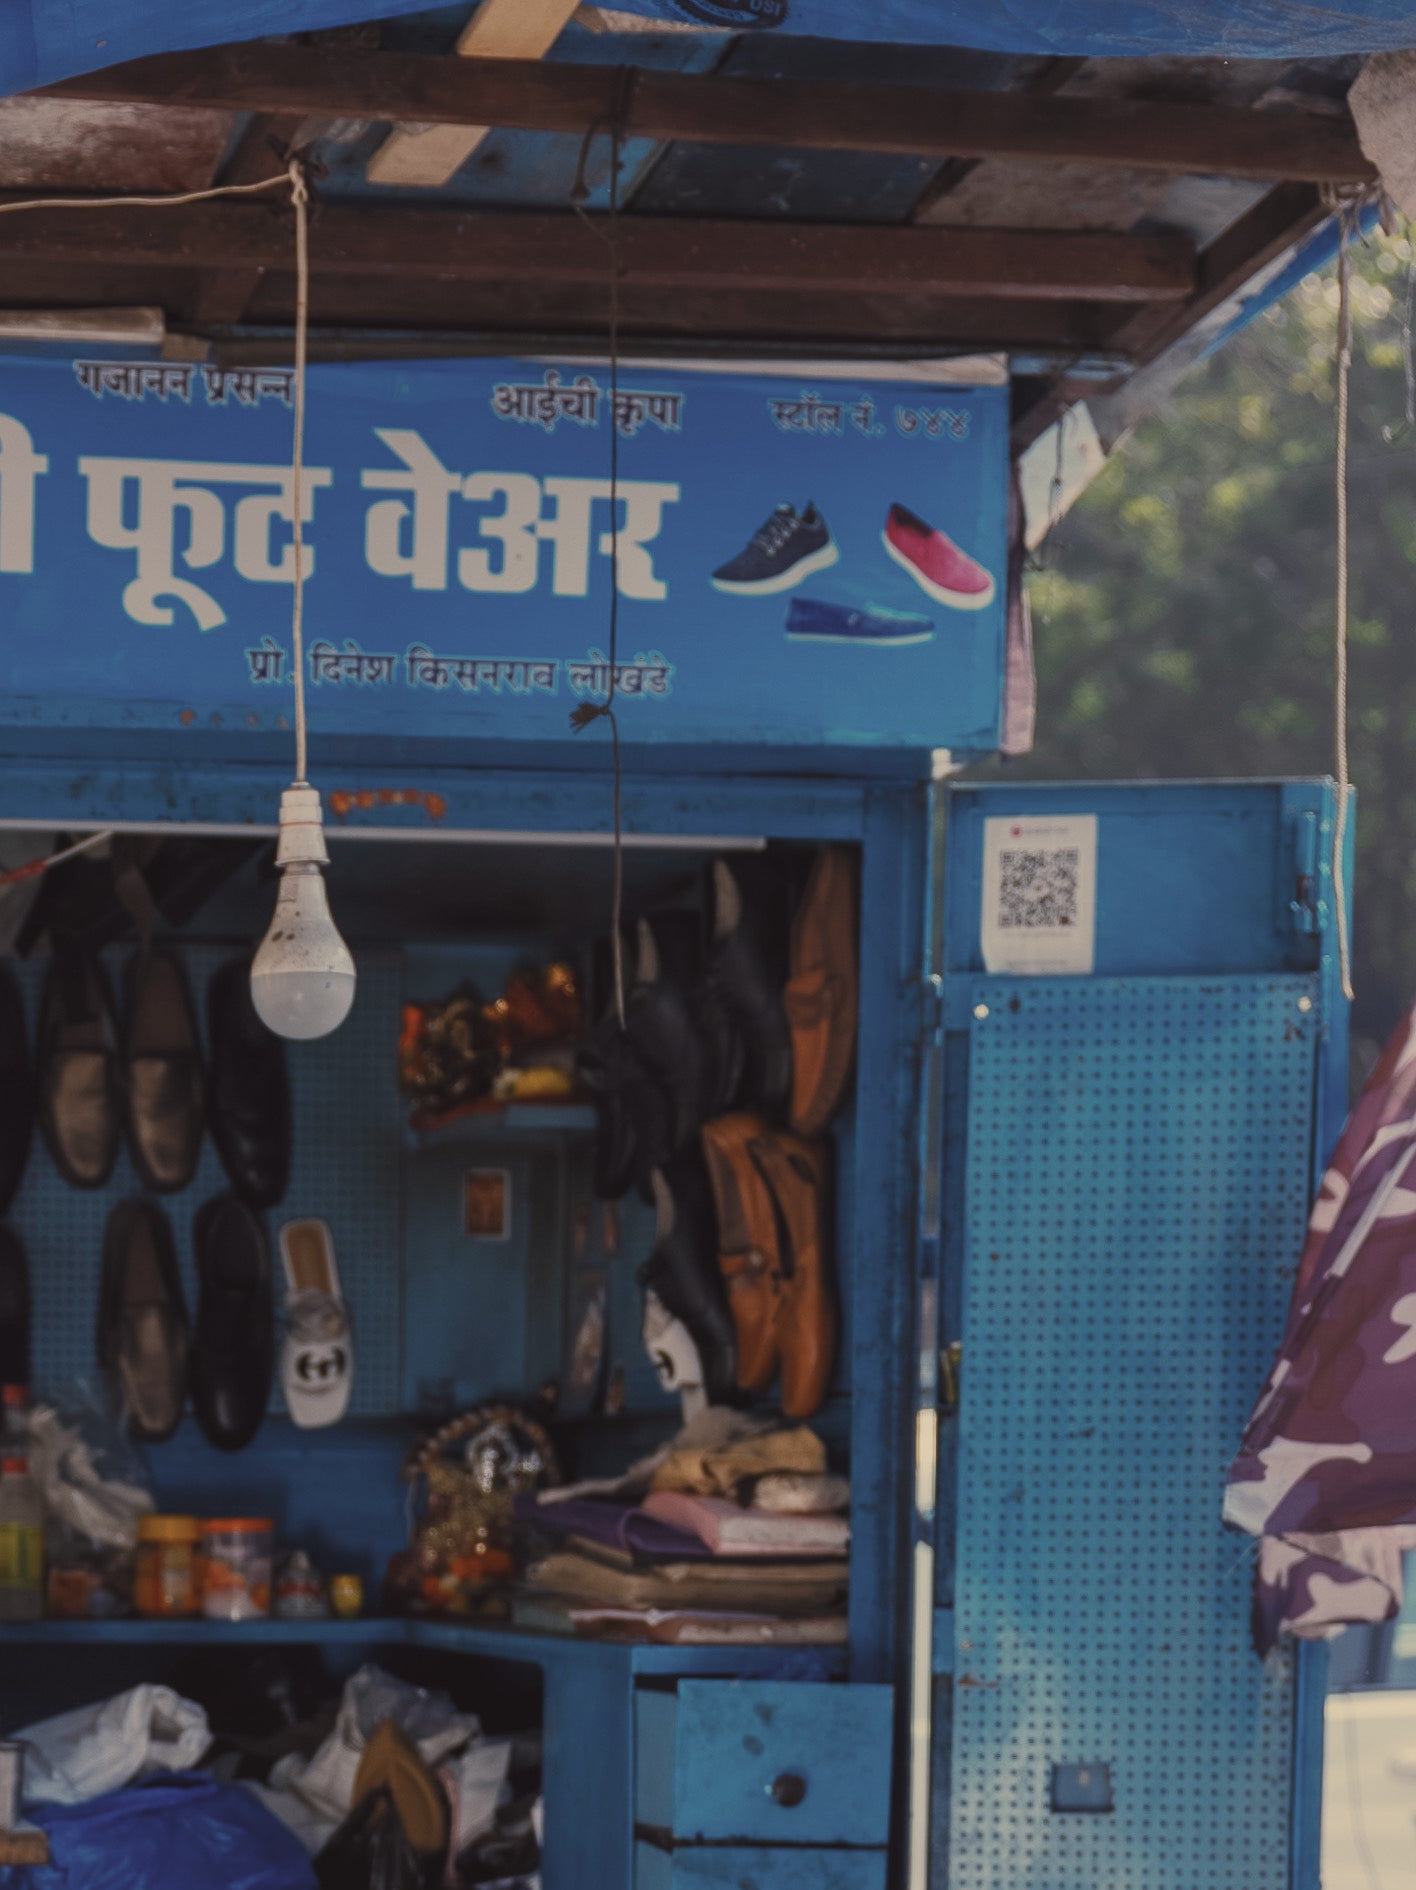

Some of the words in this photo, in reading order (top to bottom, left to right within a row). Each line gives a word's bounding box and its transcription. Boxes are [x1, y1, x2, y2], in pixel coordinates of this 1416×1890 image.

[75, 361, 194, 399] गजानन
[201, 367, 295, 403] प्रसन्न
[493, 371, 599, 430] आईची
[612, 390, 682, 437] कृपा
[771, 392, 840, 433] स्टॉल
[78, 455, 332, 630] फूट
[361, 428, 680, 600] वेअर
[310, 642, 395, 684] दिनेश
[406, 645, 558, 690] किसनराव
